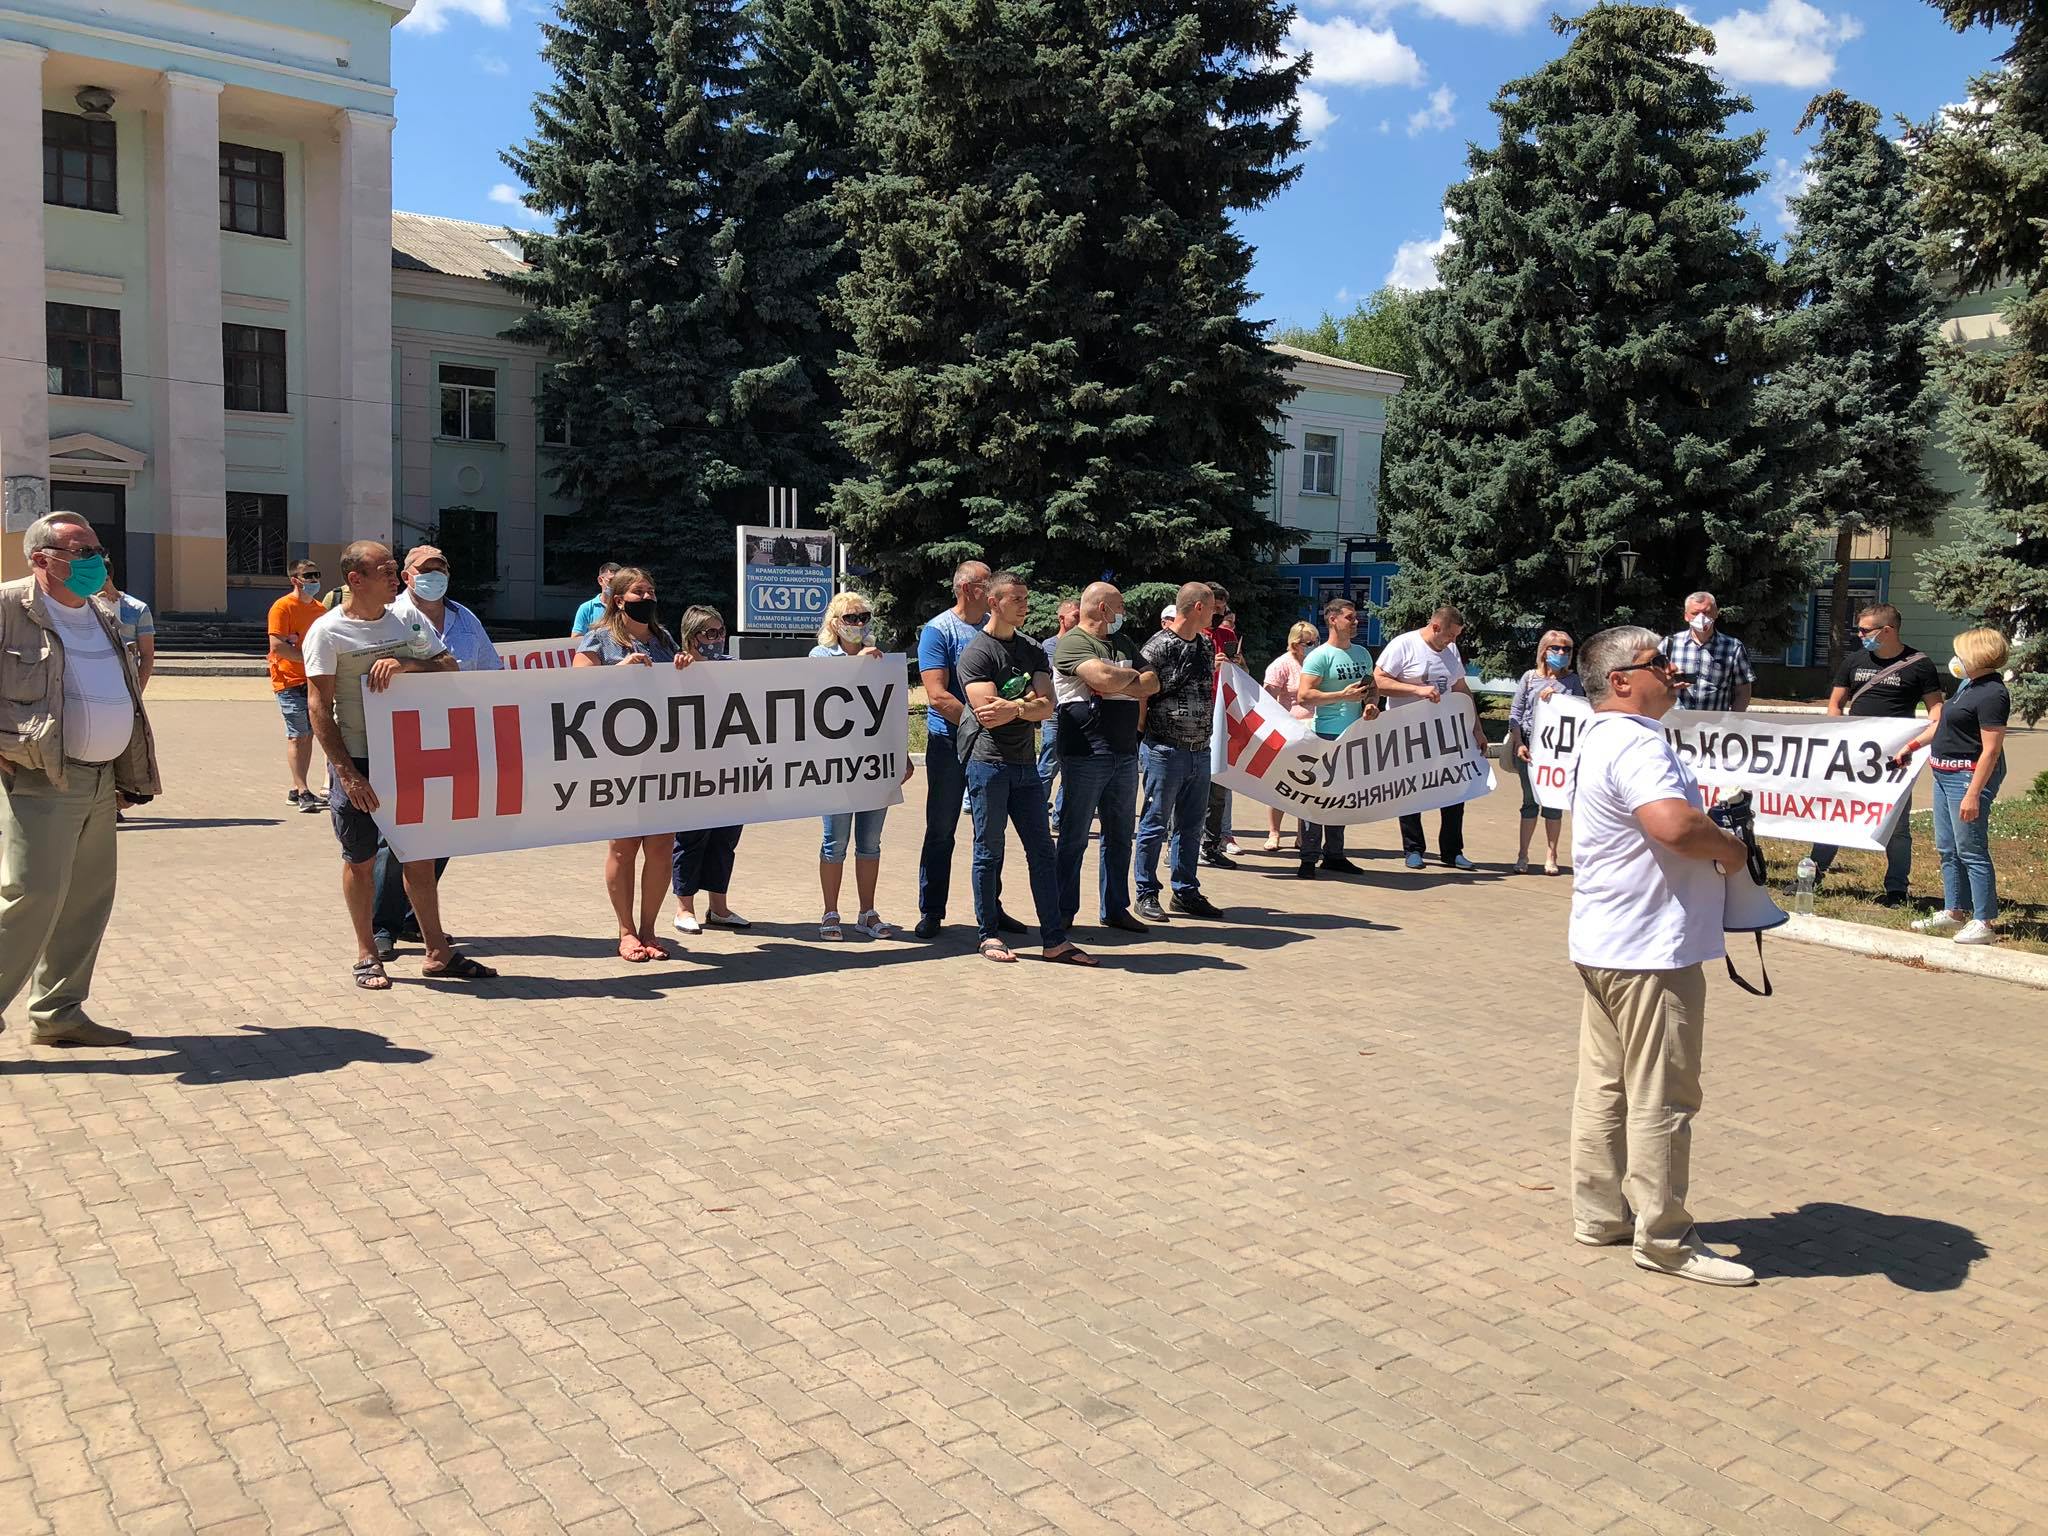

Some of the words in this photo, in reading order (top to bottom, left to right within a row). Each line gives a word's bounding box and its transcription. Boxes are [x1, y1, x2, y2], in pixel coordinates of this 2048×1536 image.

[758, 586, 821, 611] КЗТС
[551, 683, 895, 762] КОЛАПСУ
[1287, 712, 1469, 788] ЗУПИНЦІ
[391, 704, 524, 826] НІ
[553, 781, 578, 811] У
[588, 757, 774, 809] ВУГІЛЬНІЙ
[783, 752, 896, 789] ГАЛУЗІ!
[1274, 775, 1417, 810] ВІТЧИЗНЯНИХ
[1421, 760, 1483, 791] ШАХТ!
